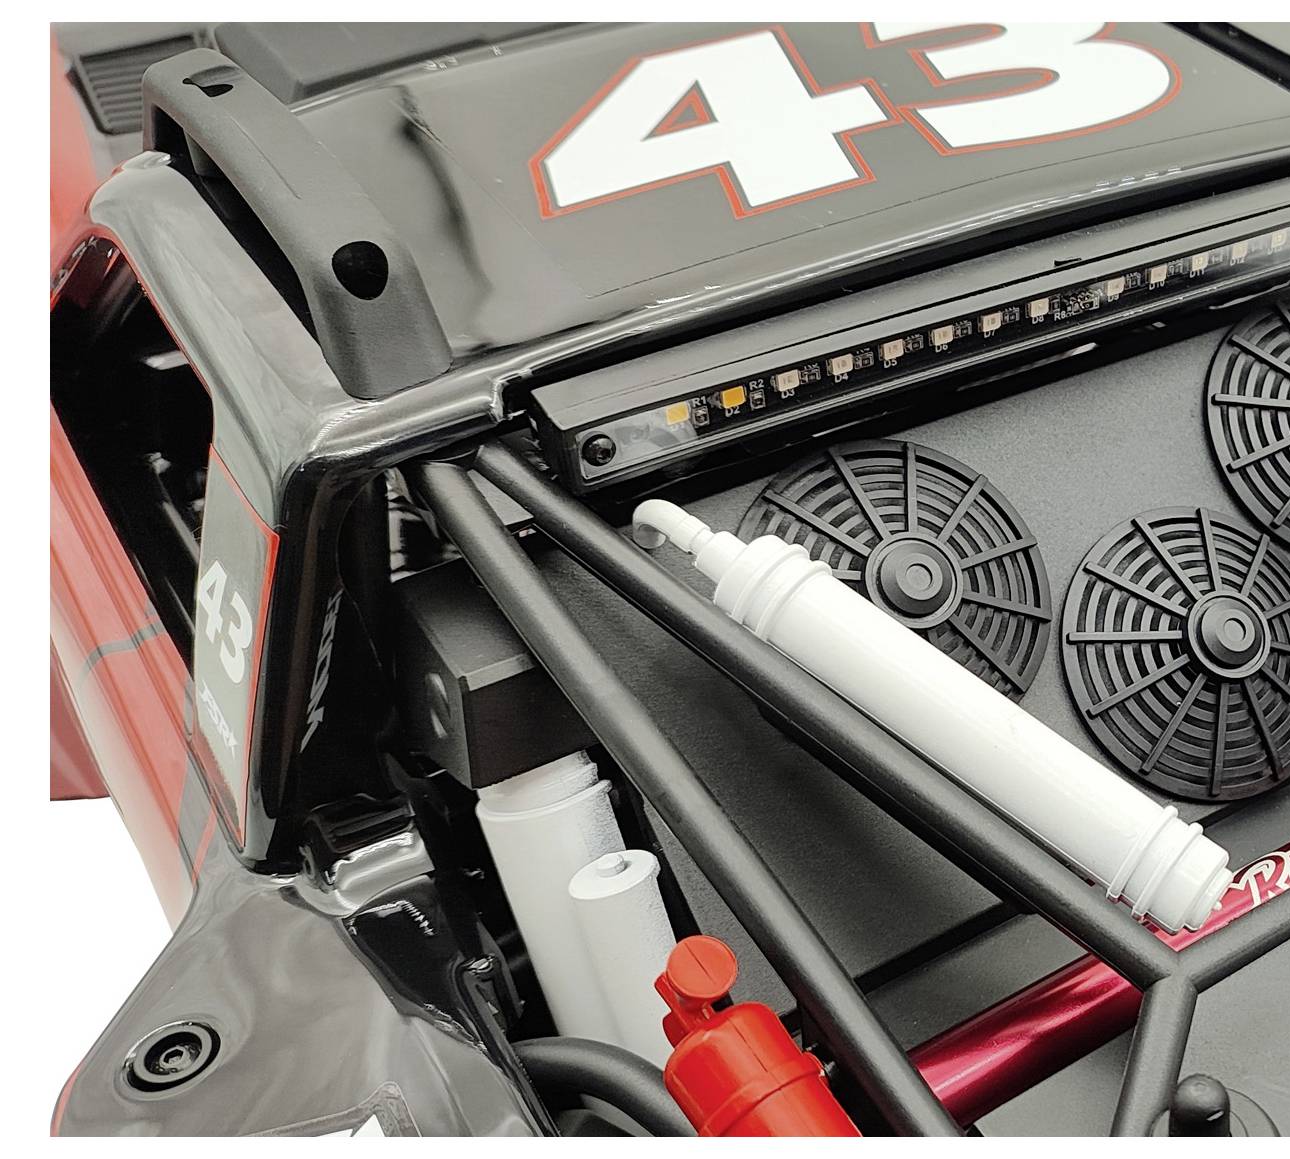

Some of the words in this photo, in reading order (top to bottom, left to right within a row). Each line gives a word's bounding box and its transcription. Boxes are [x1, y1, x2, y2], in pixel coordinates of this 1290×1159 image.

[529, 22, 1182, 219] 43
[749, 378, 764, 391] R2
[692, 395, 706, 407] R1
[725, 405, 741, 417] D2
[200, 560, 253, 683] 43
